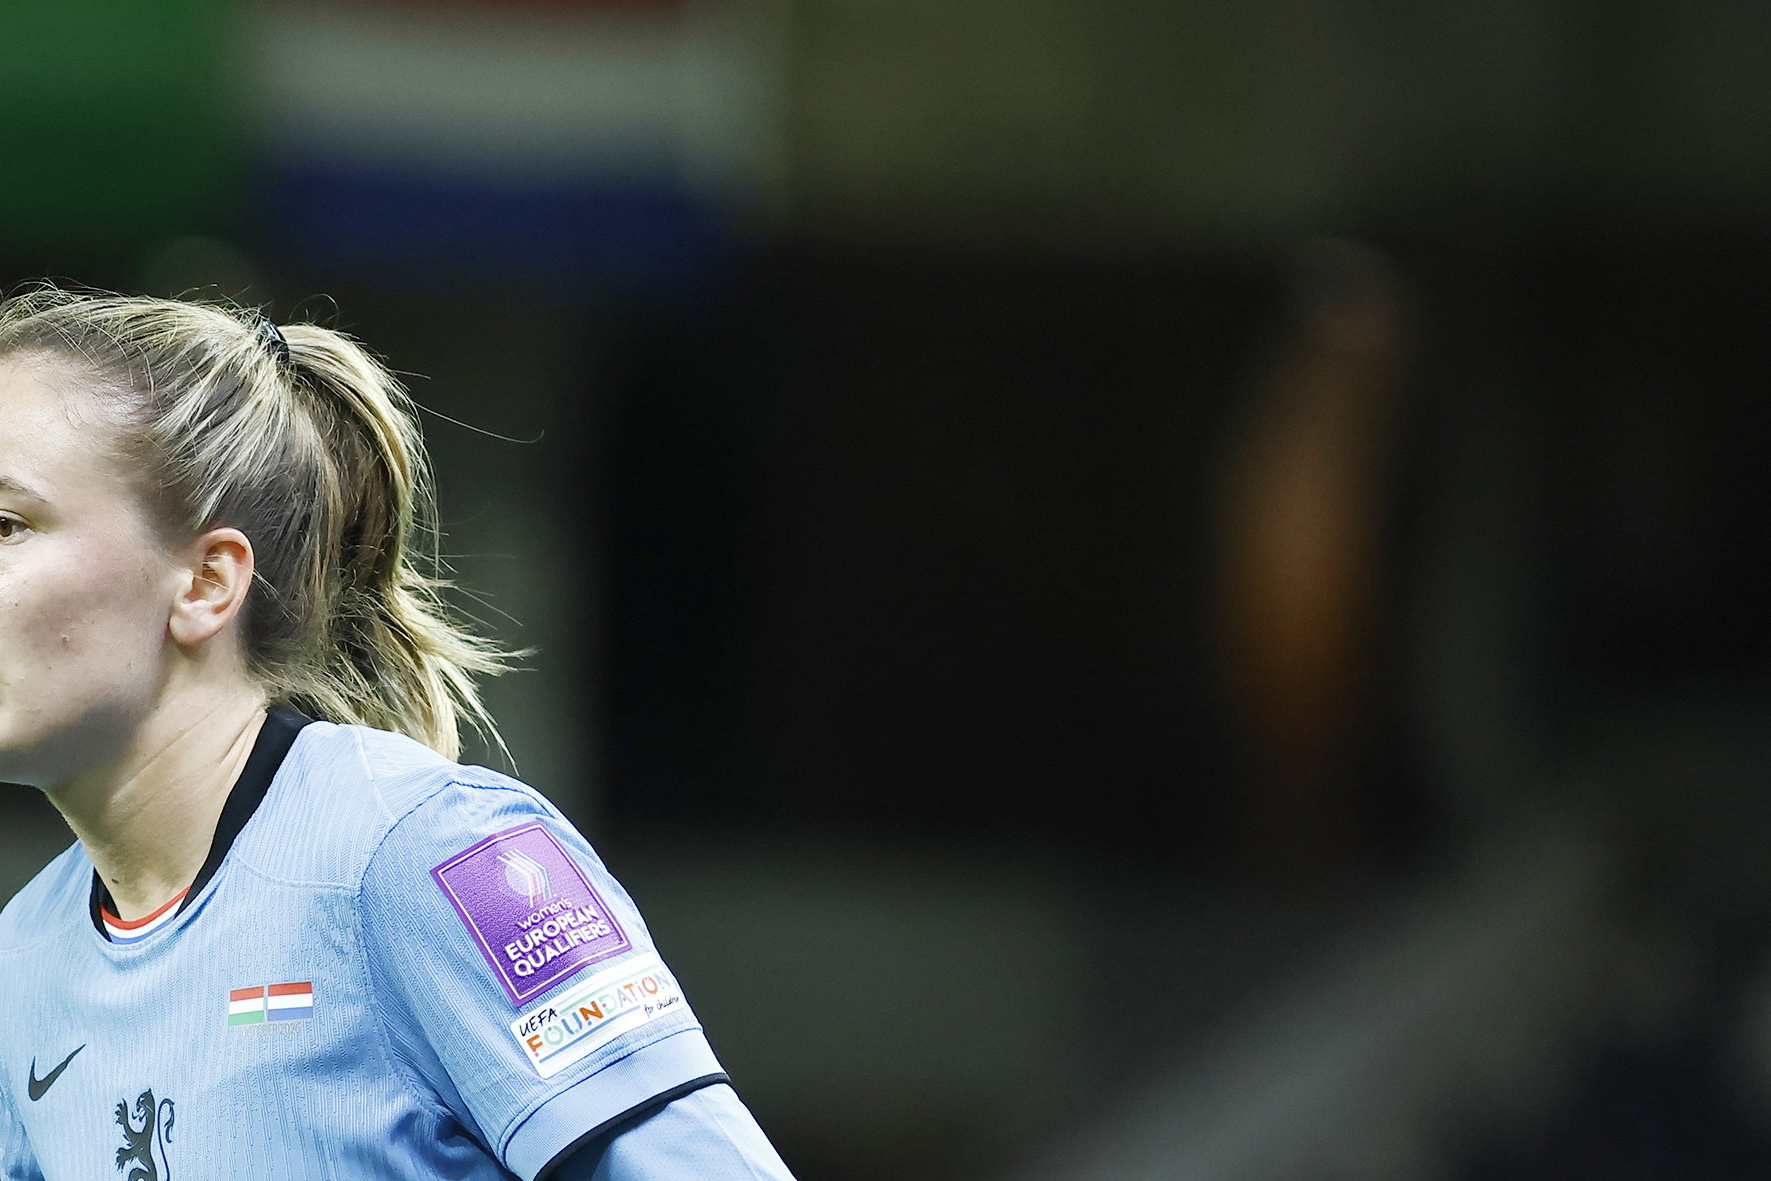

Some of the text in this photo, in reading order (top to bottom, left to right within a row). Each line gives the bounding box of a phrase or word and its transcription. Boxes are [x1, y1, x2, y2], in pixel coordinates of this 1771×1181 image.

[504, 905, 600, 961] EUROPEAN
[514, 920, 611, 977] QUALIFIERS
[519, 1007, 559, 1037] UEFA
[526, 970, 672, 1057] FOUNDATION
